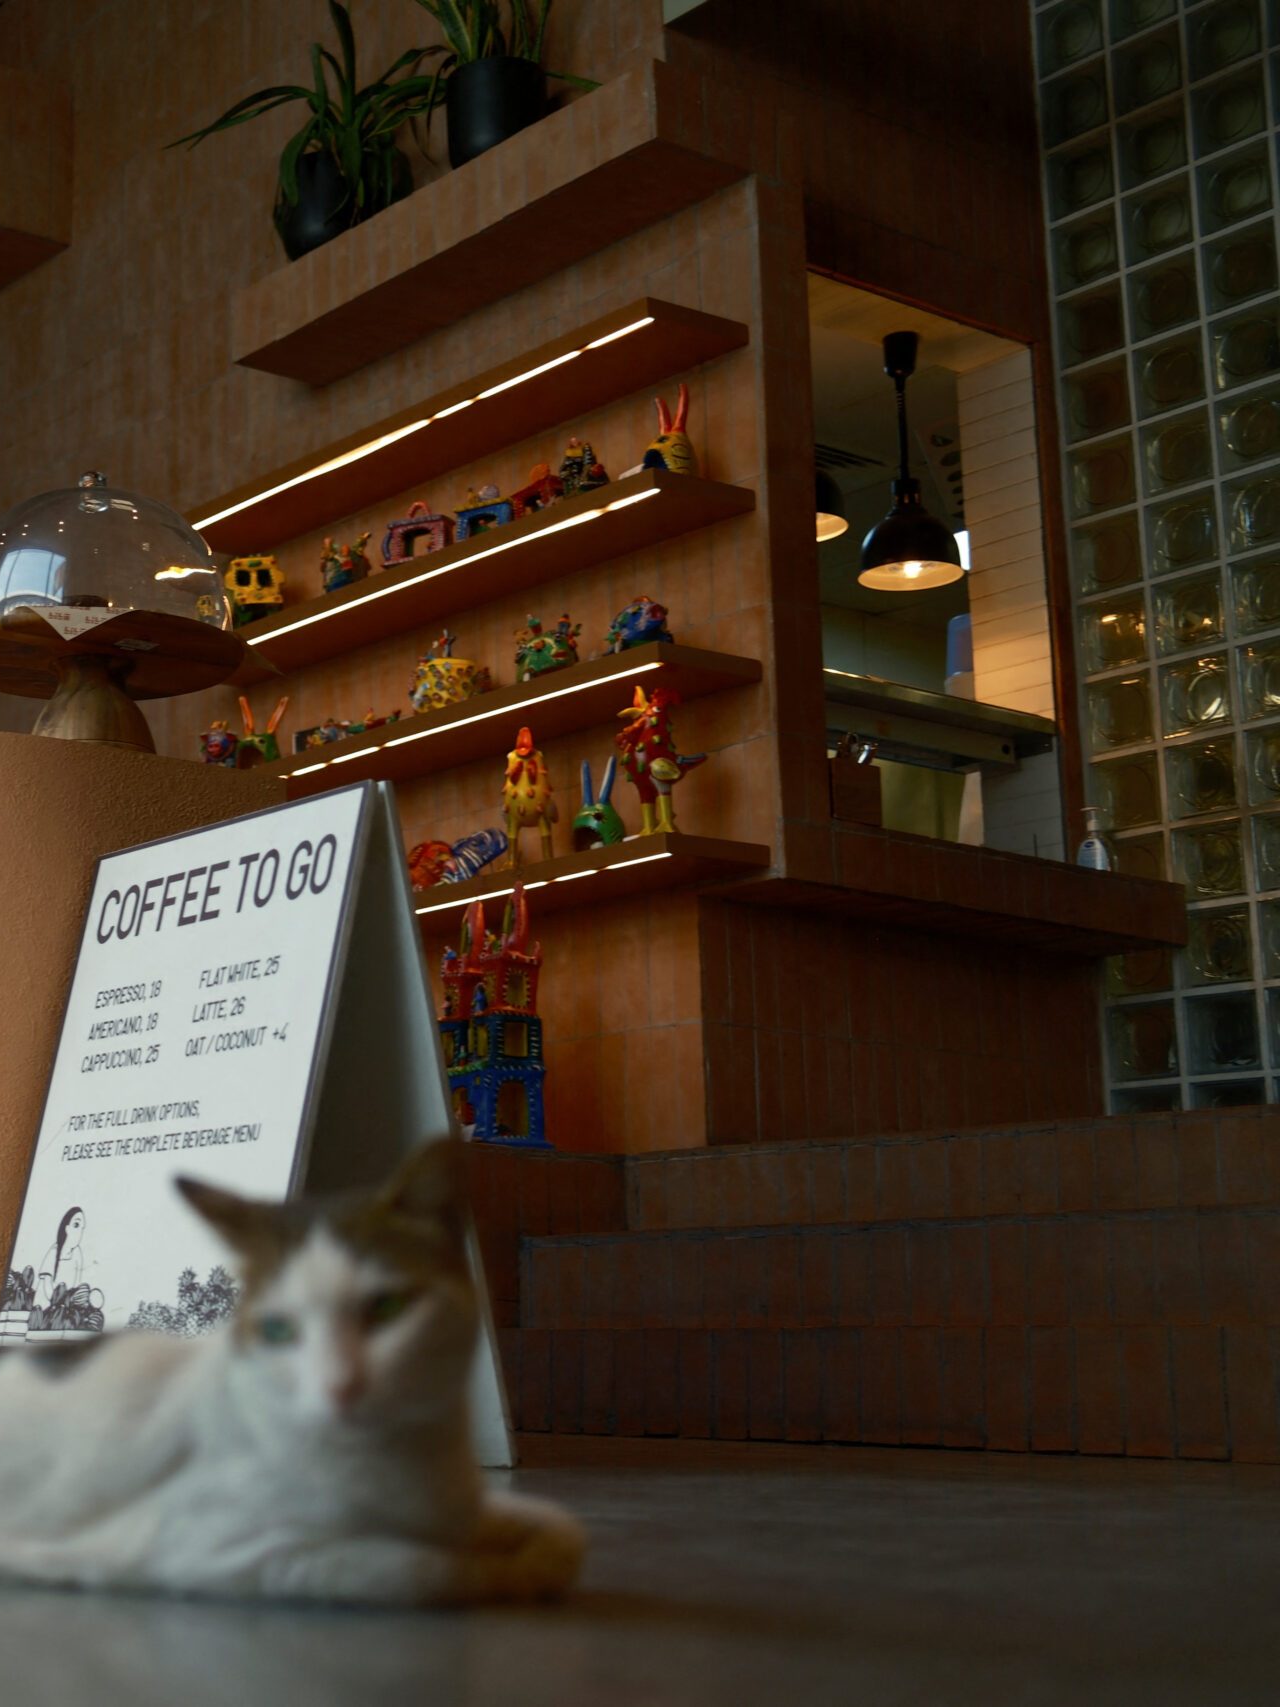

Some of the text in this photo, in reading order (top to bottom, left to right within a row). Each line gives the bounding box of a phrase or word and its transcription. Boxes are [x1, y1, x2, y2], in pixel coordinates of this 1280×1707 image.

[97, 834, 337, 944] COFFEE TO GO
[199, 955, 282, 989] FLAT WHITE, 25
[95, 980, 162, 1009] ESPRESSO, 18
[192, 996, 246, 1023] LATTE, 26
[87, 1012, 159, 1041] AMERICANO, 18
[185, 1036, 206, 1057] OAT
[215, 1026, 268, 1052] COCONUT
[273, 1022, 289, 1042] +4
[81, 1043, 161, 1073] CAPPUCCINO, 25
[68, 1114, 87, 1132] FOR
[87, 1112, 106, 1130] THE
[104, 1109, 129, 1129] FULL
[130, 1105, 160, 1125] DRINK
[61, 1123, 262, 1161] PLEASE SEE THE COMPLETE BEVERAGE MENU
